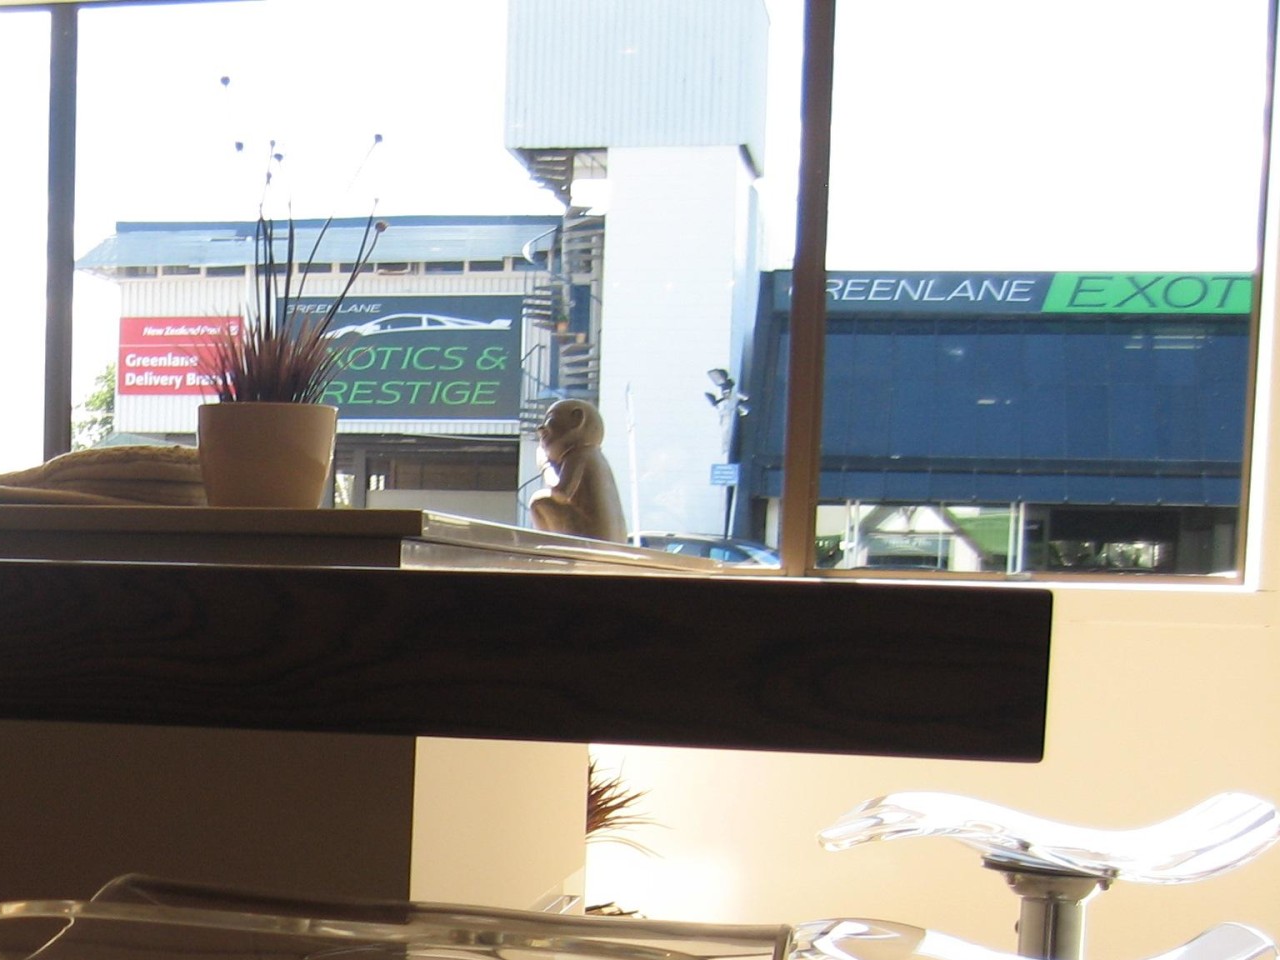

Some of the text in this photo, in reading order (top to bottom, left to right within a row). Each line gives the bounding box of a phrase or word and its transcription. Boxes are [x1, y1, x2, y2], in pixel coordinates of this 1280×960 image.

[788, 279, 1036, 302] REENLANE
[125, 352, 198, 368] Greenlane
[475, 346, 509, 371] &
[124, 371, 183, 390] Delivery
[318, 380, 500, 405] RESTIGE
